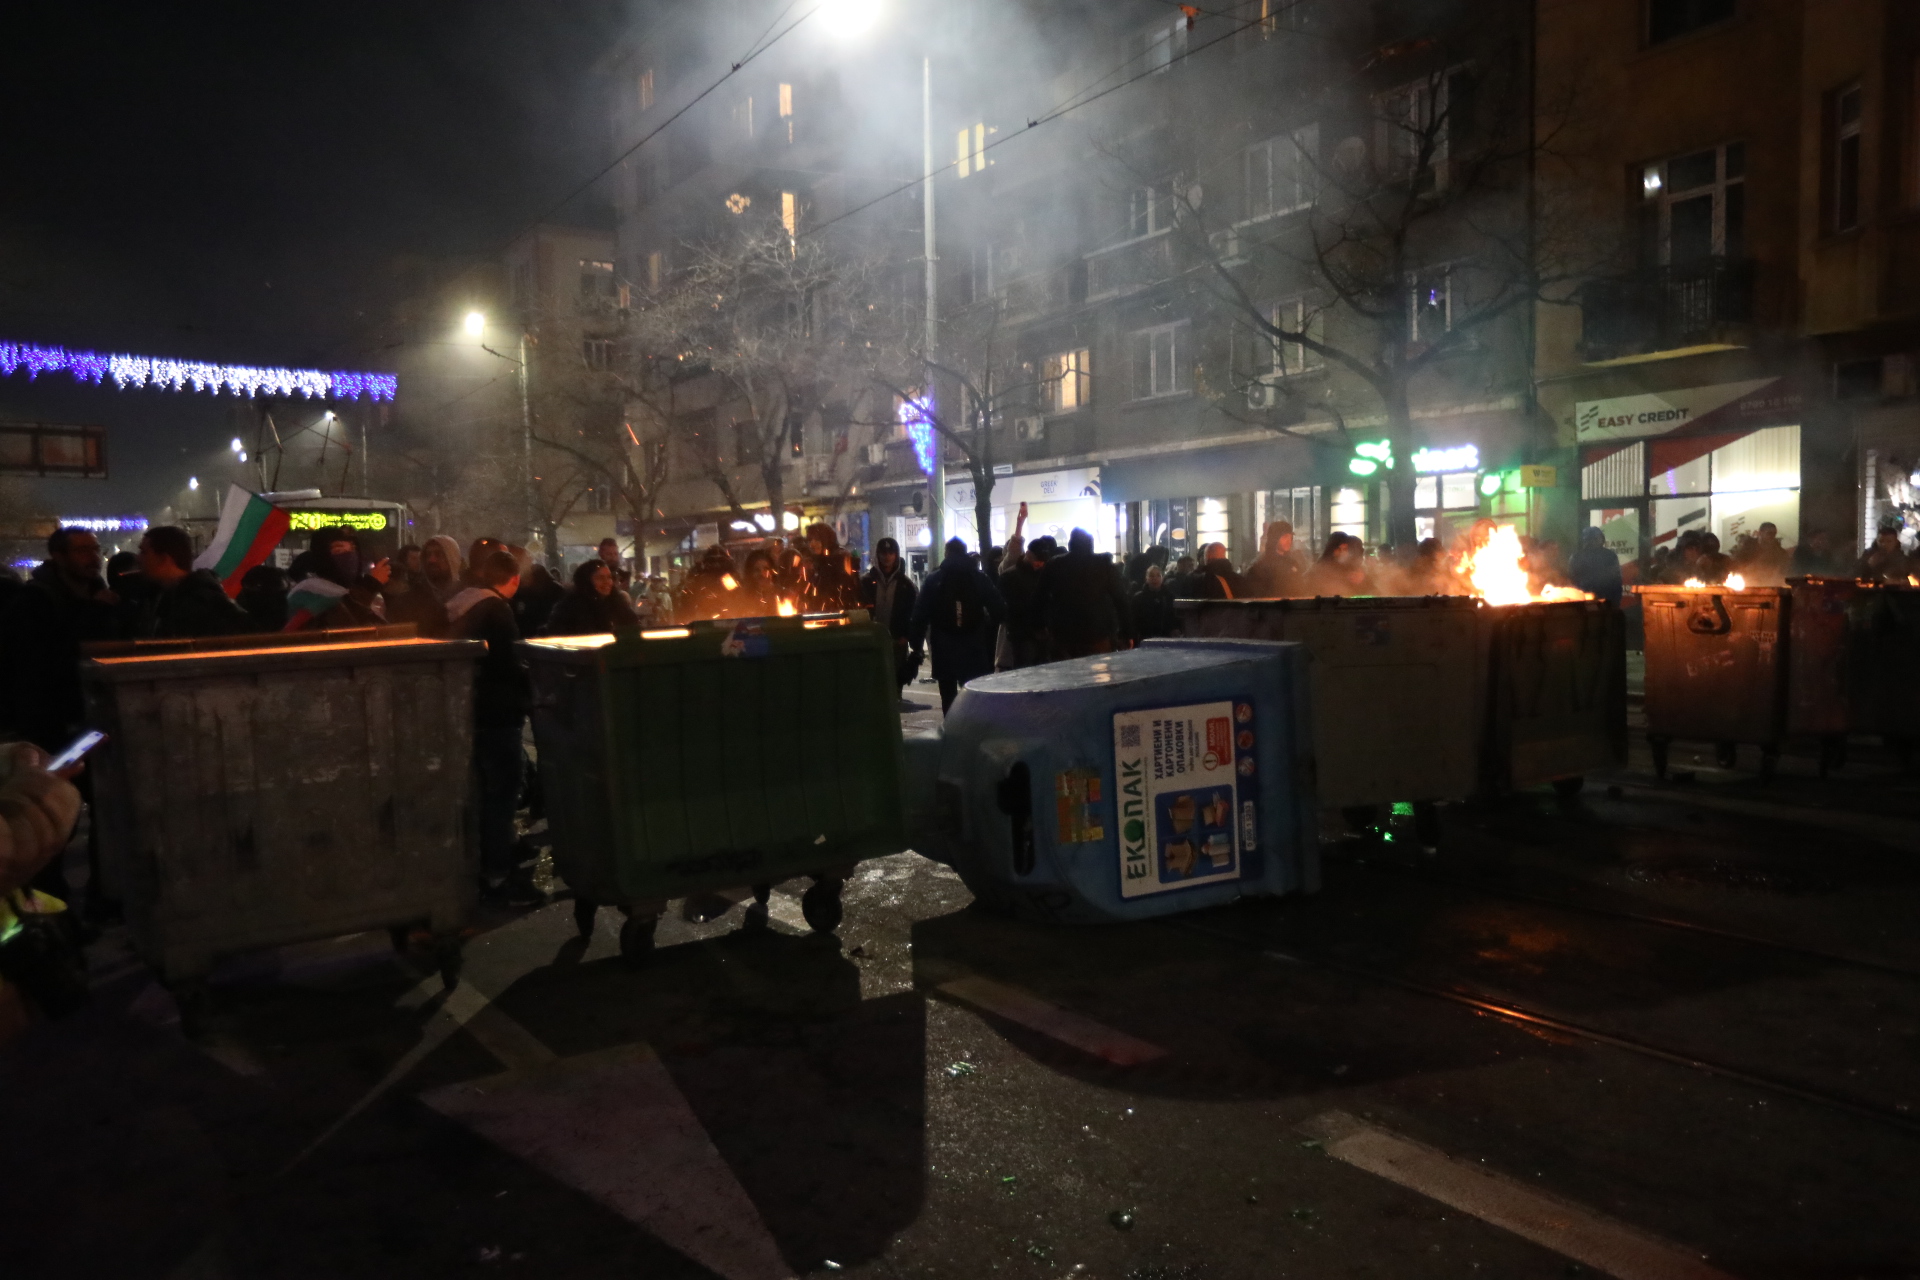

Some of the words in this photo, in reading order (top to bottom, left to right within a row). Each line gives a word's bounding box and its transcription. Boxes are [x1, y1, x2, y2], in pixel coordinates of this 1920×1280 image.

[1597, 414, 1635, 428] EASY
[1637, 407, 1690, 424] CREDIT
[1040, 480, 1058, 488] GREEK
[1153, 720, 1162, 728] И
[1164, 719, 1175, 777] КАРТОНЕНИ
[1175, 721, 1186, 774] ОПАКОВКИ
[1154, 729, 1164, 780] ХАРТИЕНИ
[1122, 758, 1146, 879] ЕКОПАК
